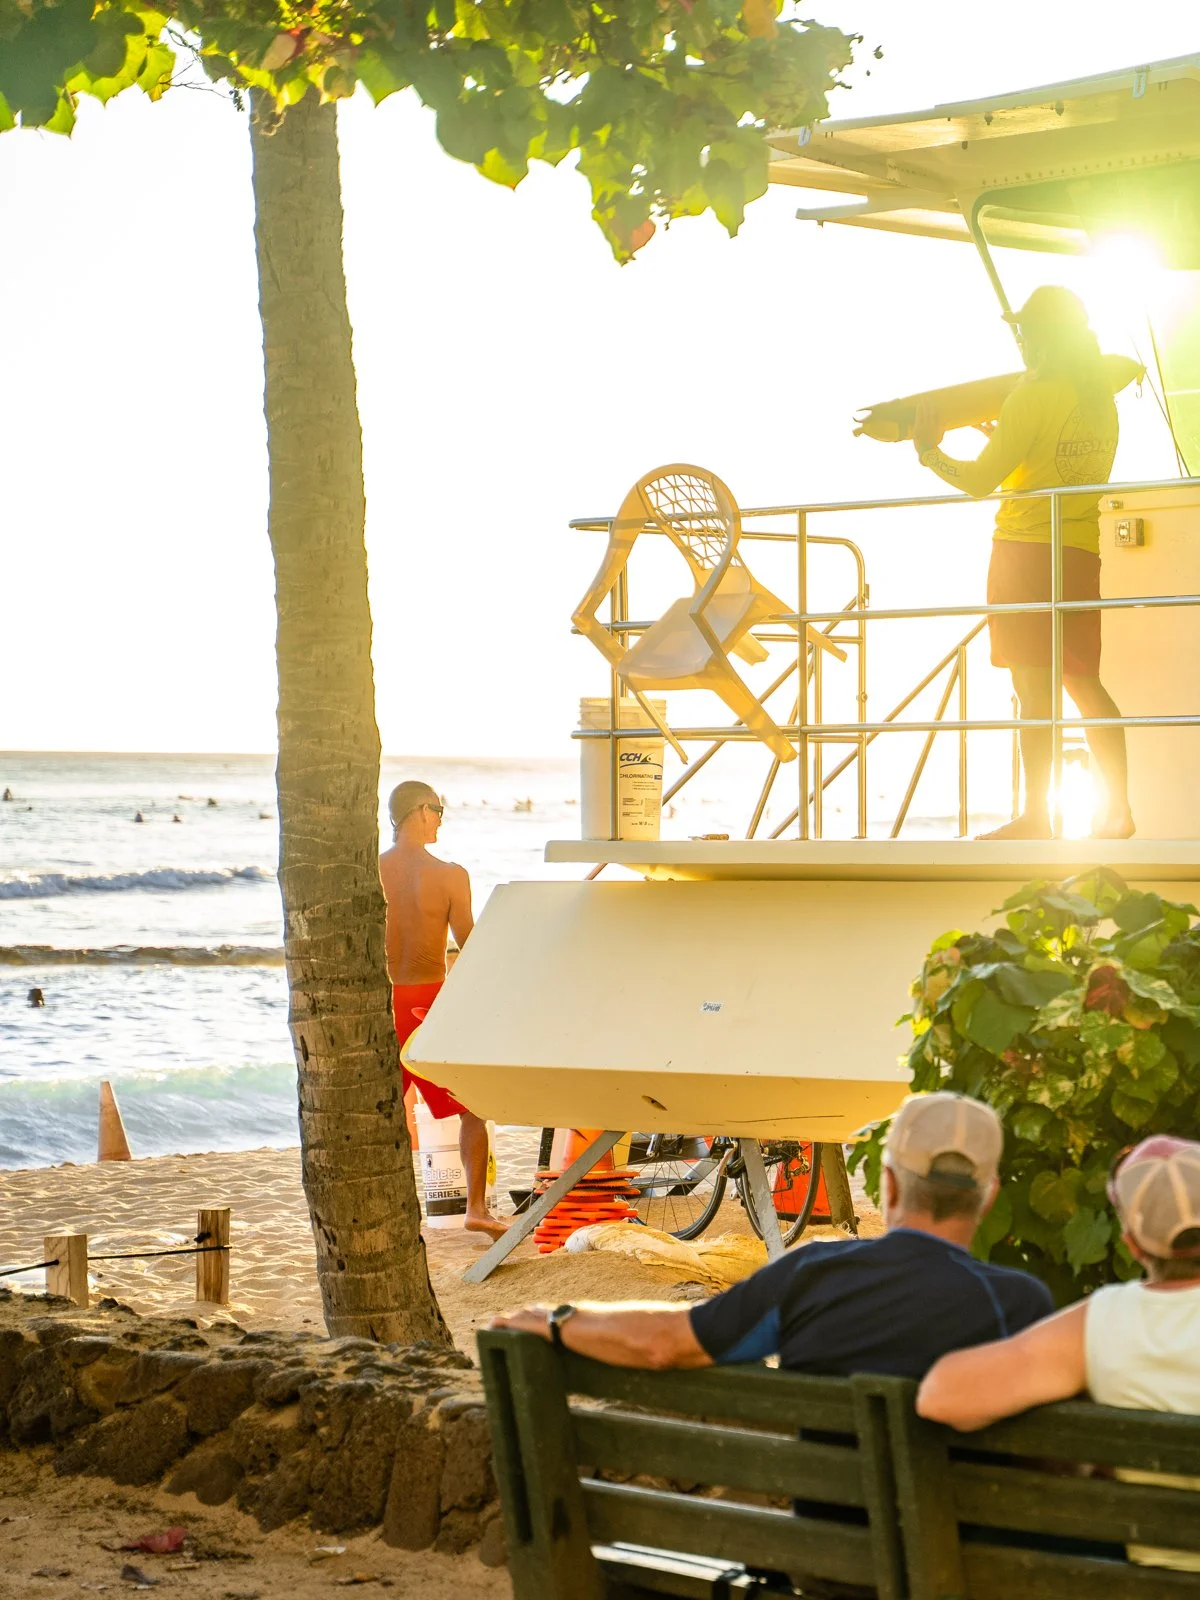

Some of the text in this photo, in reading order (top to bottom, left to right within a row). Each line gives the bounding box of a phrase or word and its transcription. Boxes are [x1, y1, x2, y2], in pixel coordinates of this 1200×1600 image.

[619, 752, 642, 762] CCH
[424, 1168, 462, 1181] ablets
[428, 1190, 461, 1199] SERIES
